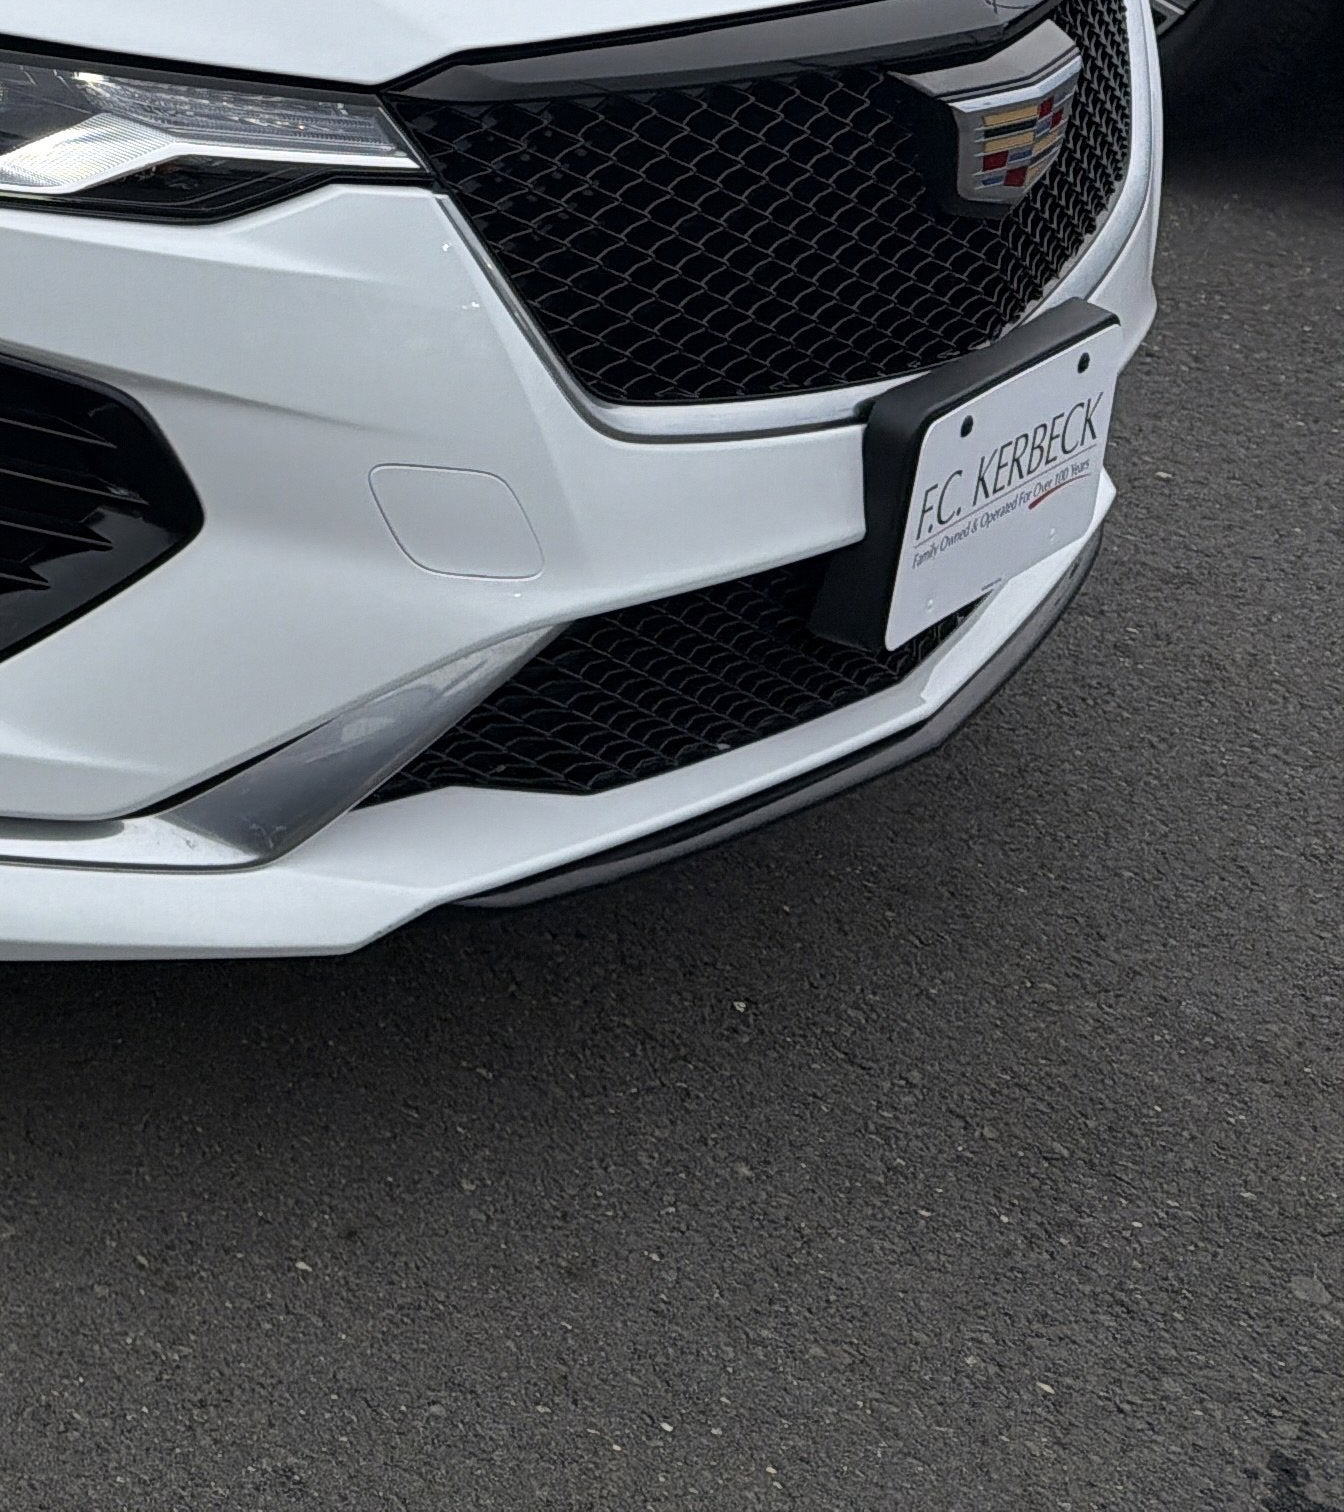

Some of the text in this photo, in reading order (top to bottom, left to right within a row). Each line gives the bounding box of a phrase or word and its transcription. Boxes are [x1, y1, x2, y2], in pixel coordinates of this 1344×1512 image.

[912, 458, 1090, 569] Family Owned & Operated For Over 100 Years
[916, 391, 1104, 541] F.C. KERBECK
